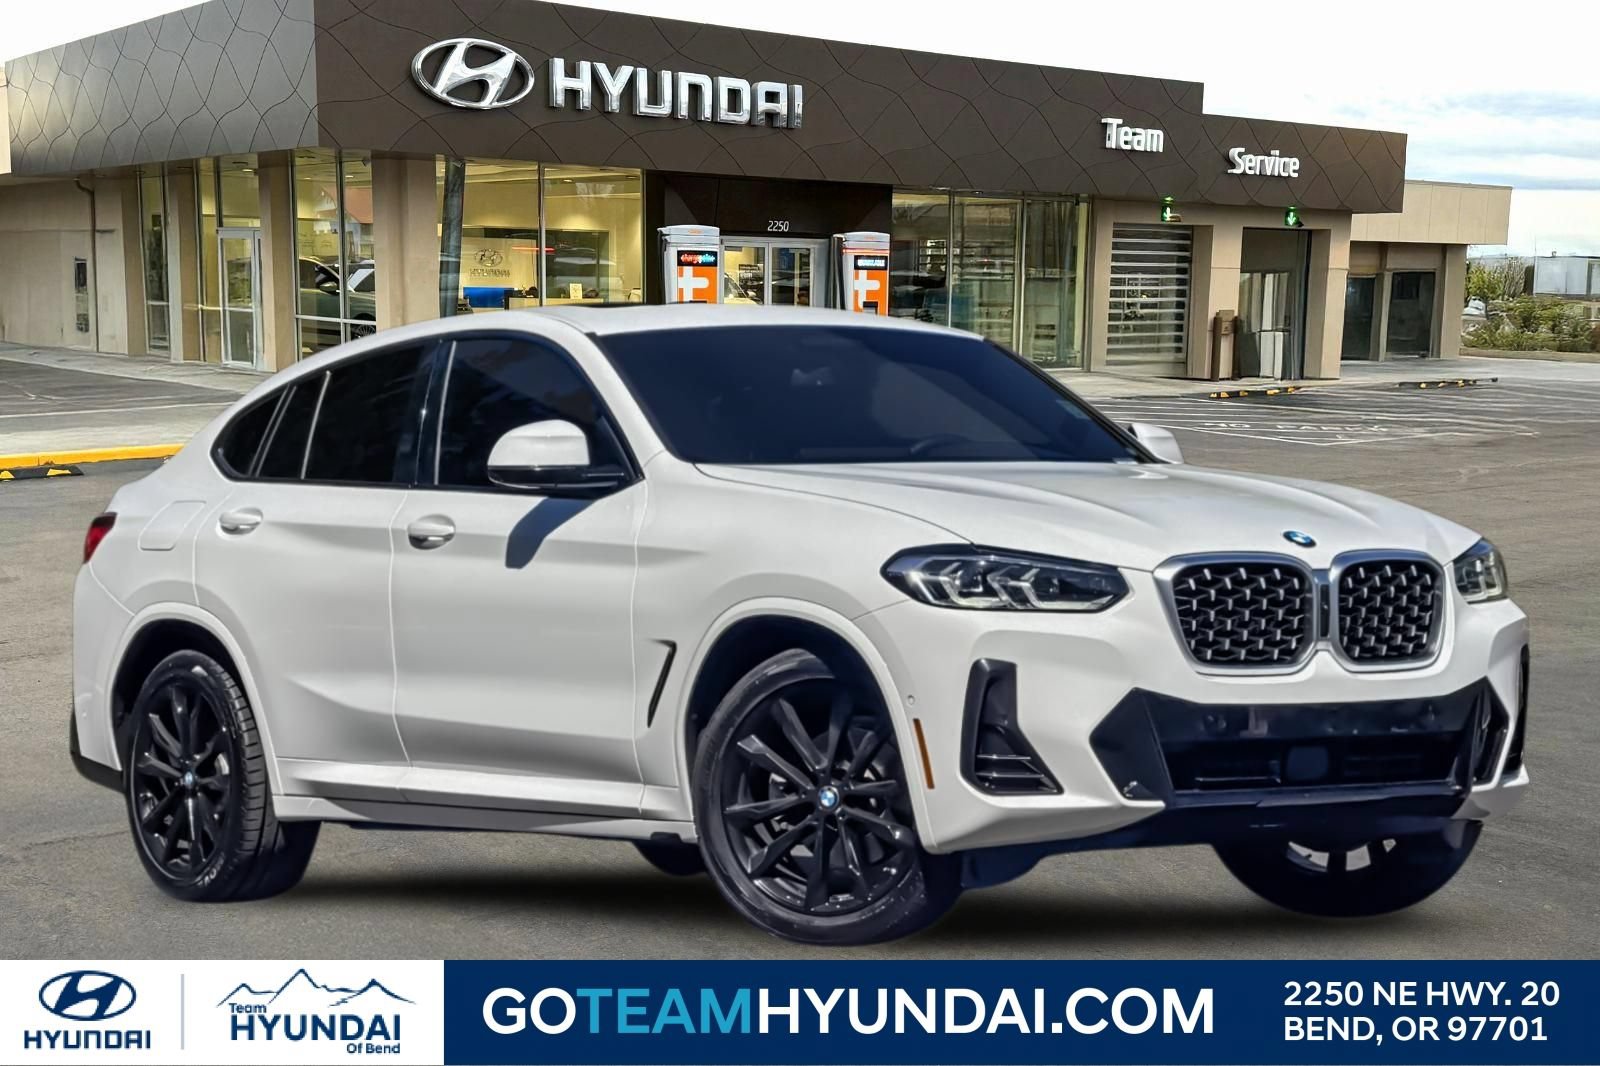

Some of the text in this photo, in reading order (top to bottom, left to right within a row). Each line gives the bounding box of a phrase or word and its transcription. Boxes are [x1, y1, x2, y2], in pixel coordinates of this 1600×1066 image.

[548, 57, 803, 129] HYUNDAI
[1101, 117, 1164, 152] Team
[1227, 147, 1300, 178] Service
[767, 220, 790, 232] 2250
